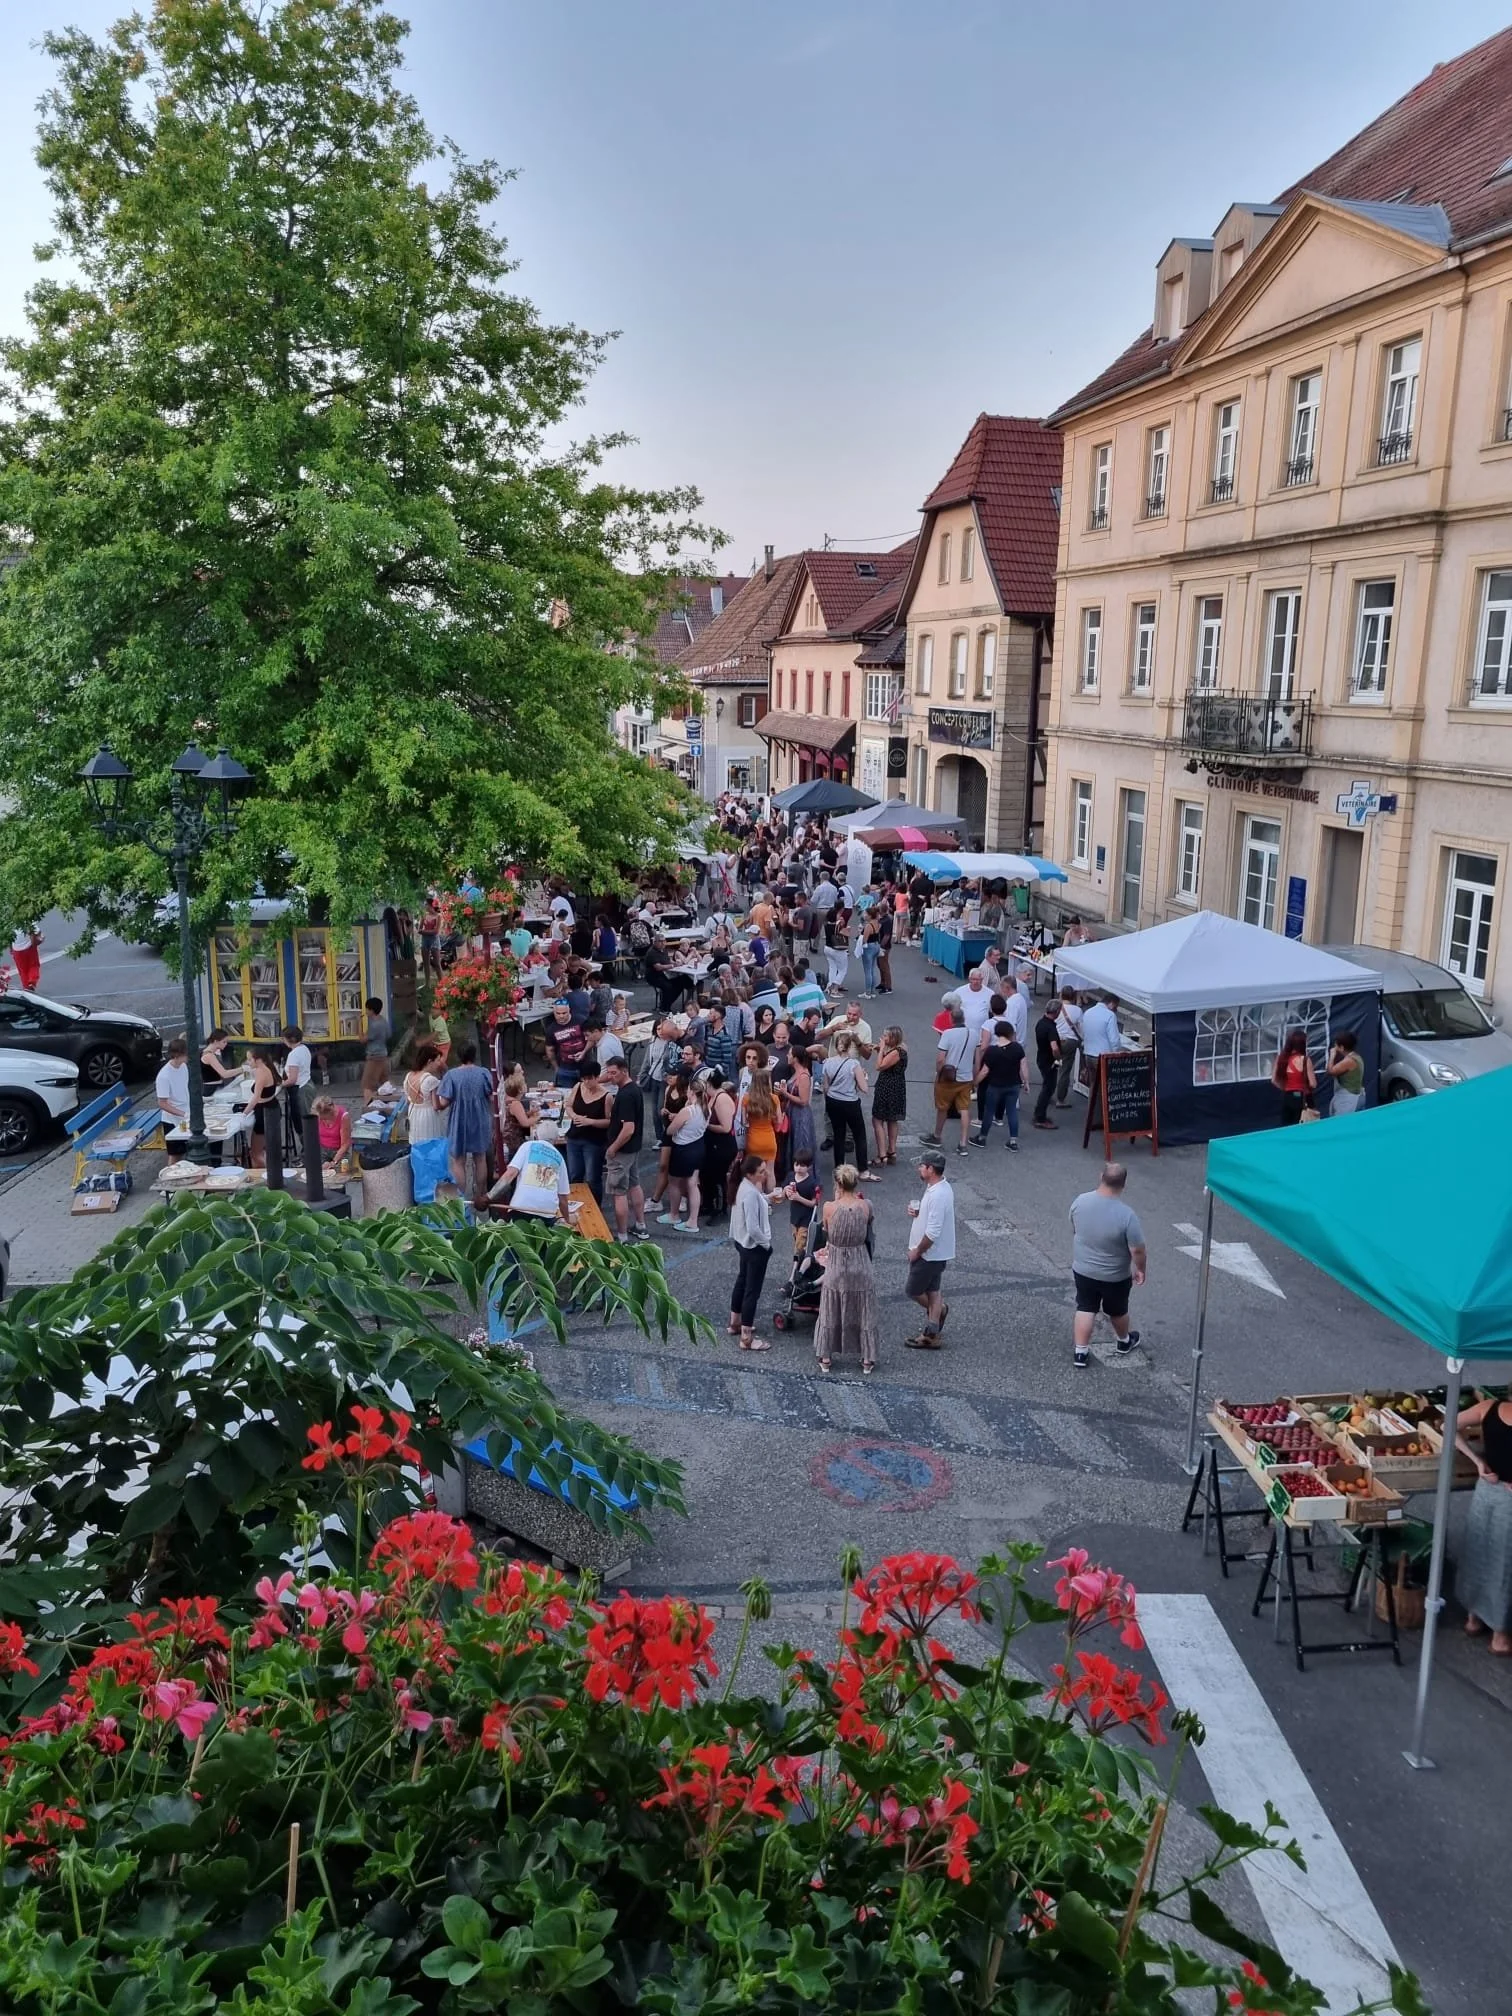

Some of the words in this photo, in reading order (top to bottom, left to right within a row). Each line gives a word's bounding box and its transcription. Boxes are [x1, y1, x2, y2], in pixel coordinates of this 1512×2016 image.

[931, 712, 958, 726] CONCEPT
[1207, 775, 1259, 794] CLINIQUE
[1262, 782, 1320, 804] VETERINAIRE
